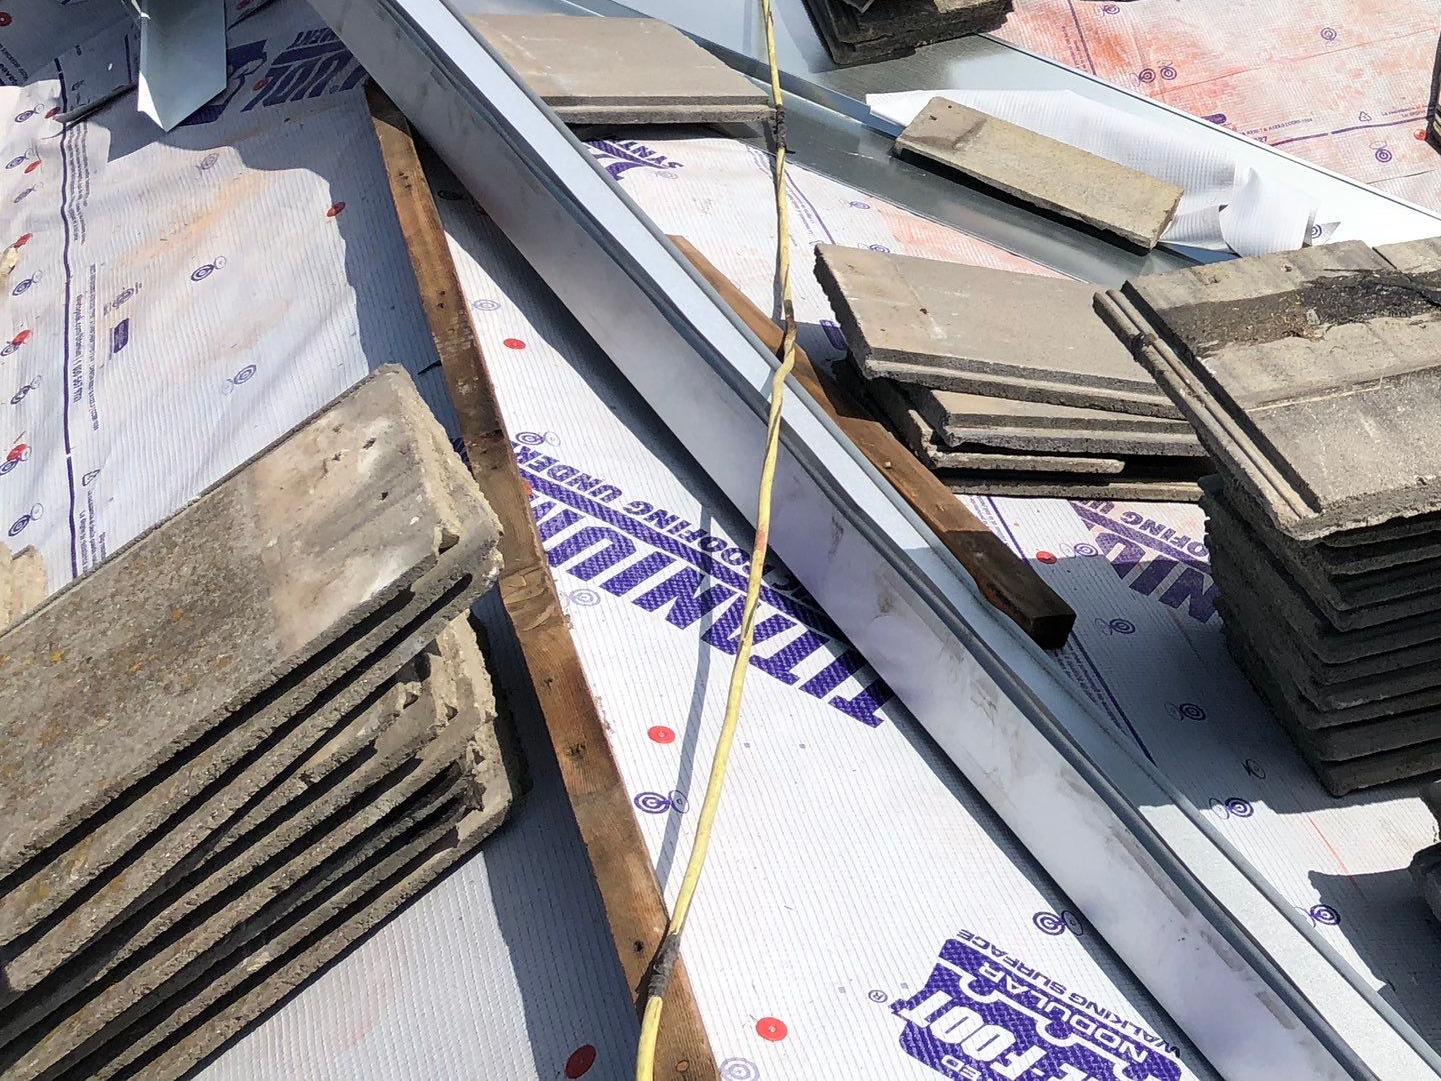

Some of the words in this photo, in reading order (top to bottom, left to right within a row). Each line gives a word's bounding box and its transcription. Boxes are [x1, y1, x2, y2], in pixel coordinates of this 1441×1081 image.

[956, 928, 1068, 996] SURFACE
[978, 961, 1149, 1064] NODULAR
[1069, 991, 1181, 1059] WALKING
